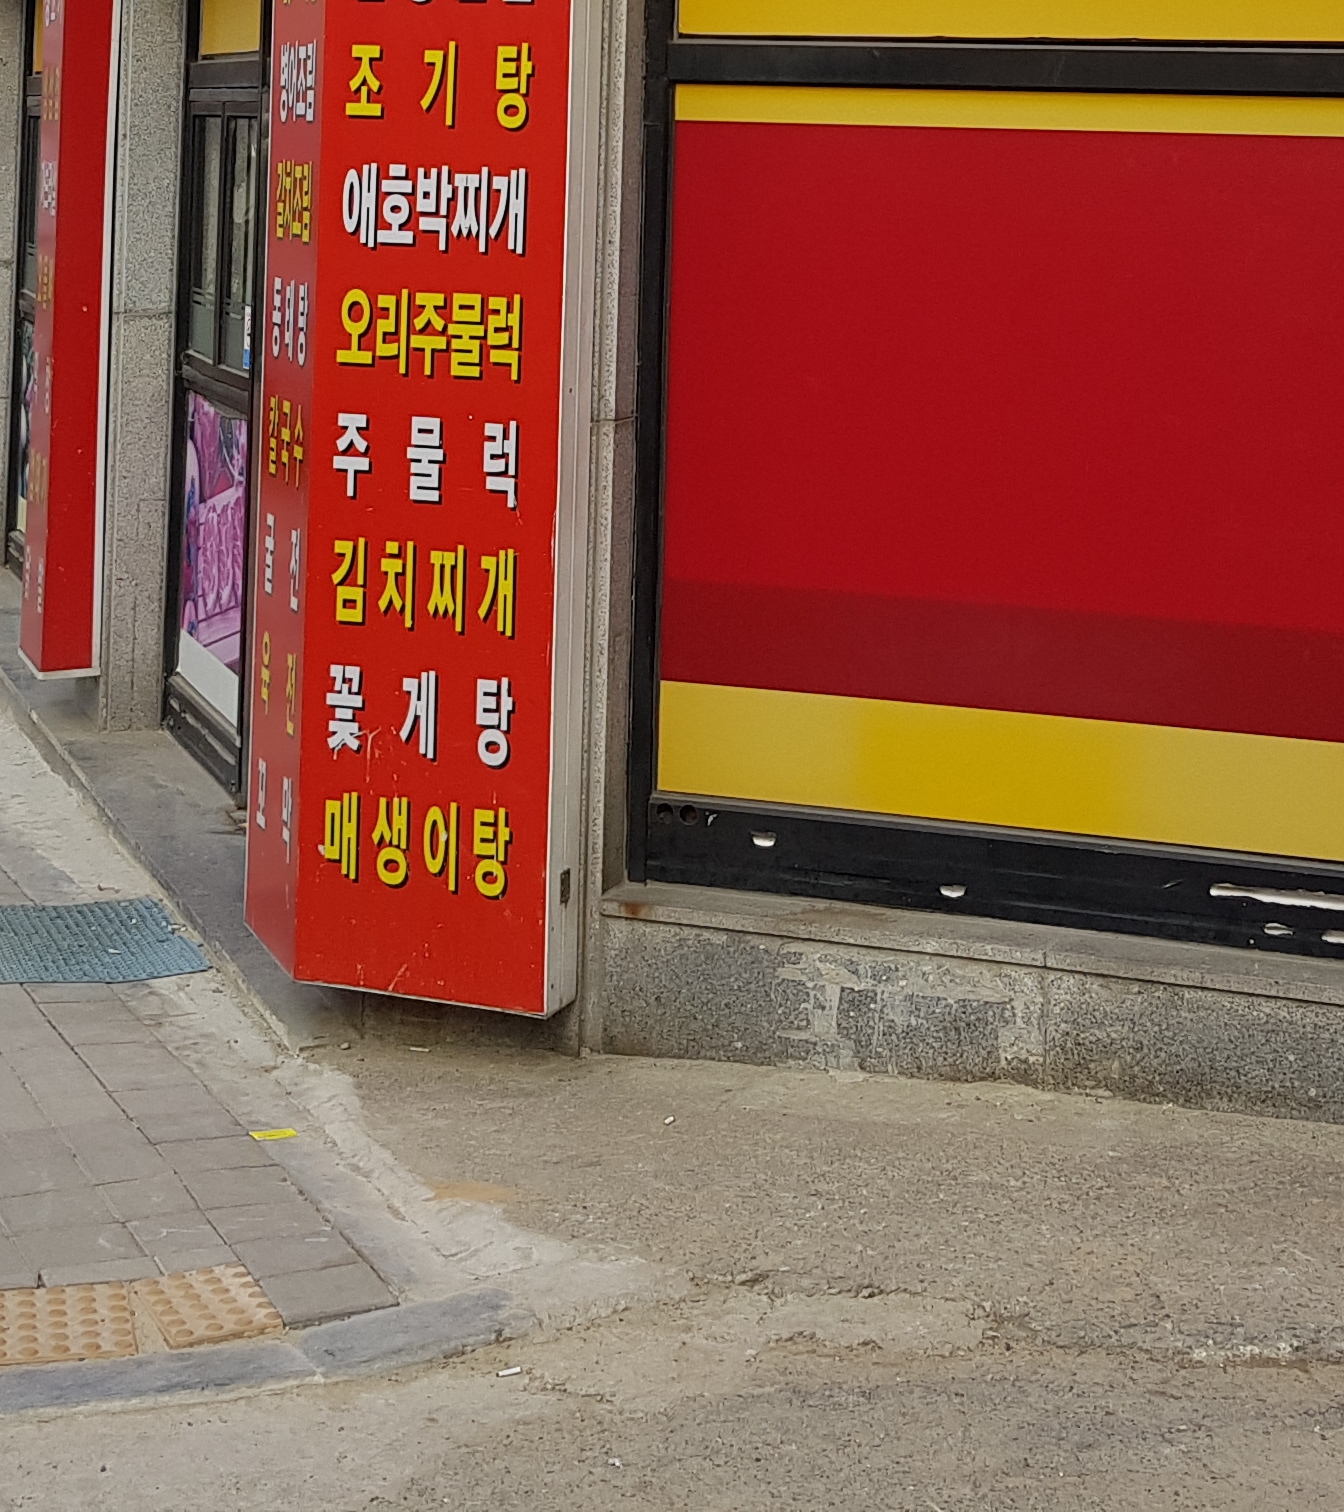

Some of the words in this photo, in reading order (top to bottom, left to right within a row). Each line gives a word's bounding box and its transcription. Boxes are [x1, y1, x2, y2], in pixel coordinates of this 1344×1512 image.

[279, 39, 316, 123] 병어조림
[345, 41, 533, 129] 조기탕
[276, 159, 312, 243] 갈치조림
[342, 163, 527, 255] 애호박찌개
[336, 289, 522, 381] 오리주물럭
[268, 395, 304, 488] 칼국수
[333, 413, 517, 508] 주물럭
[331, 537, 515, 637] 김치찌개
[326, 664, 513, 768] 꽃게탕
[323, 792, 511, 897] 매생이탕
